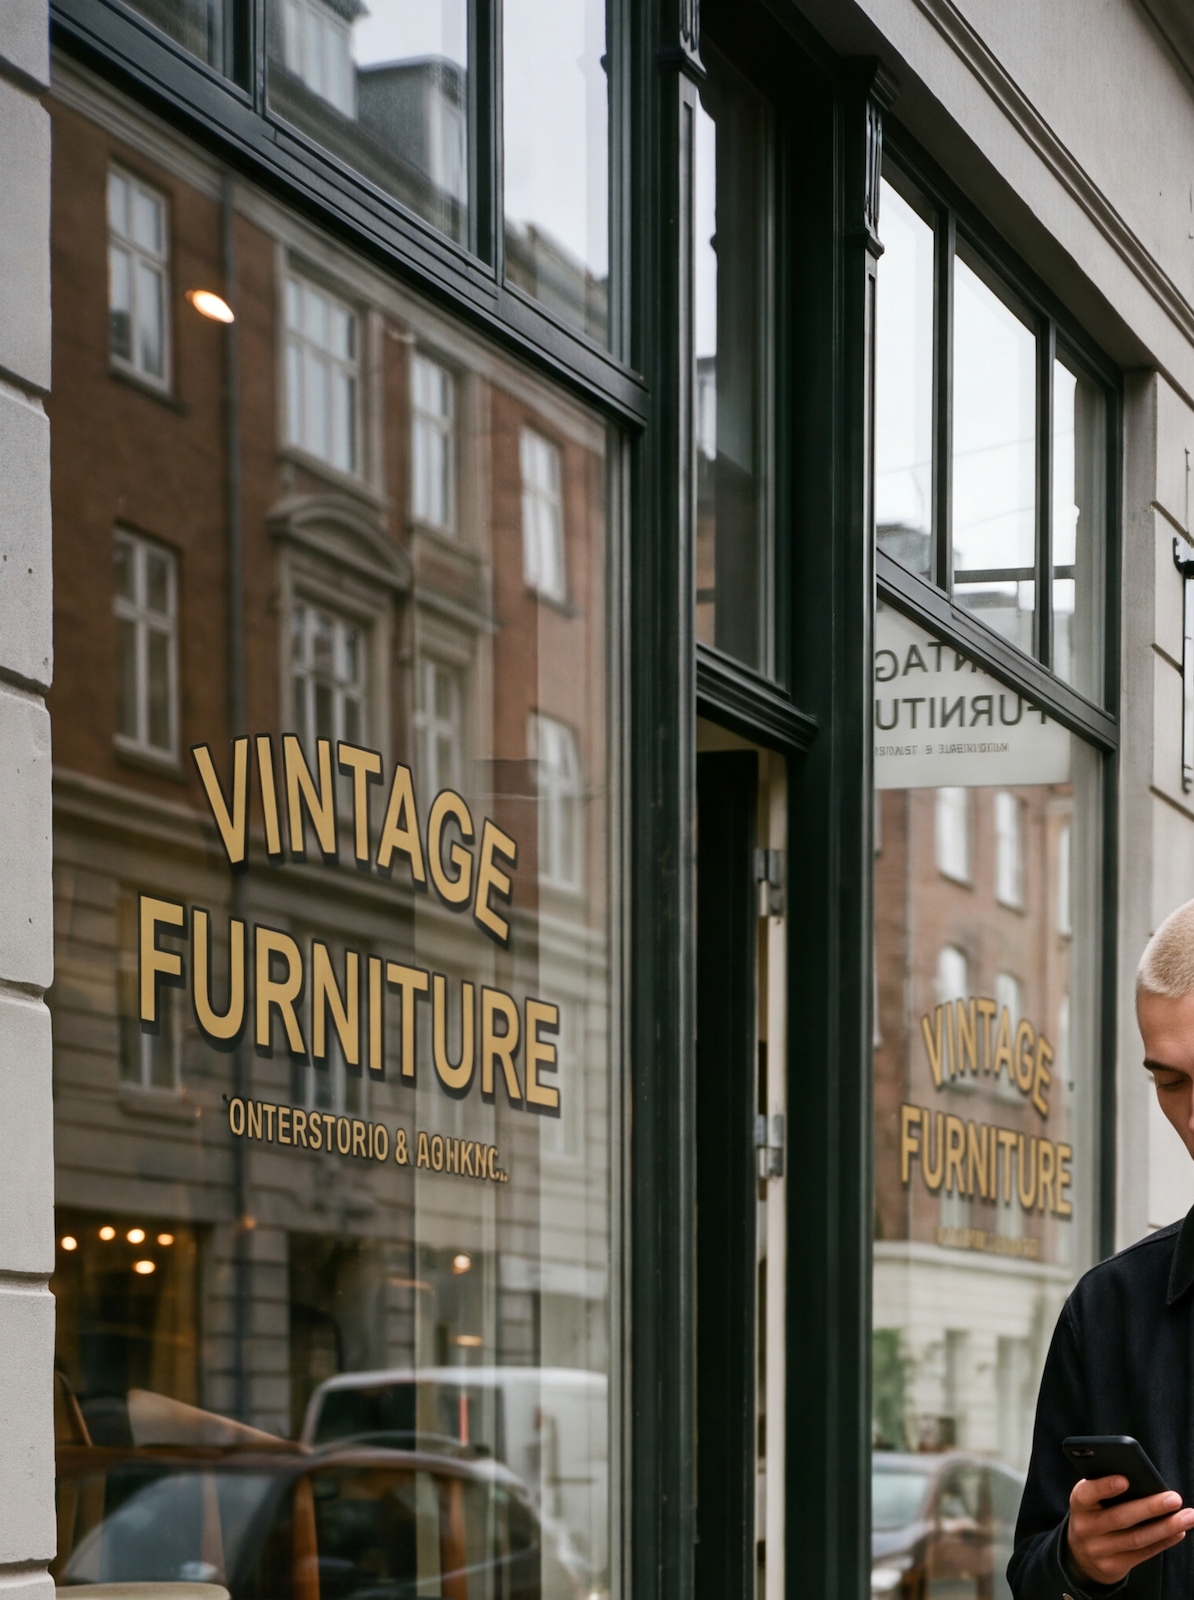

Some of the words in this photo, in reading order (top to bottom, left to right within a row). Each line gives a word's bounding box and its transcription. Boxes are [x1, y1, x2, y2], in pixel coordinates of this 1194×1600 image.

[191, 732, 519, 945] VINTAGE
[138, 892, 562, 1114] FURNITURE
[919, 996, 1055, 1119] VINTAGE
[229, 1097, 389, 1162] ONTERSTORIO
[394, 1128, 408, 1165] &
[900, 1103, 1073, 1218] FURNITURE
